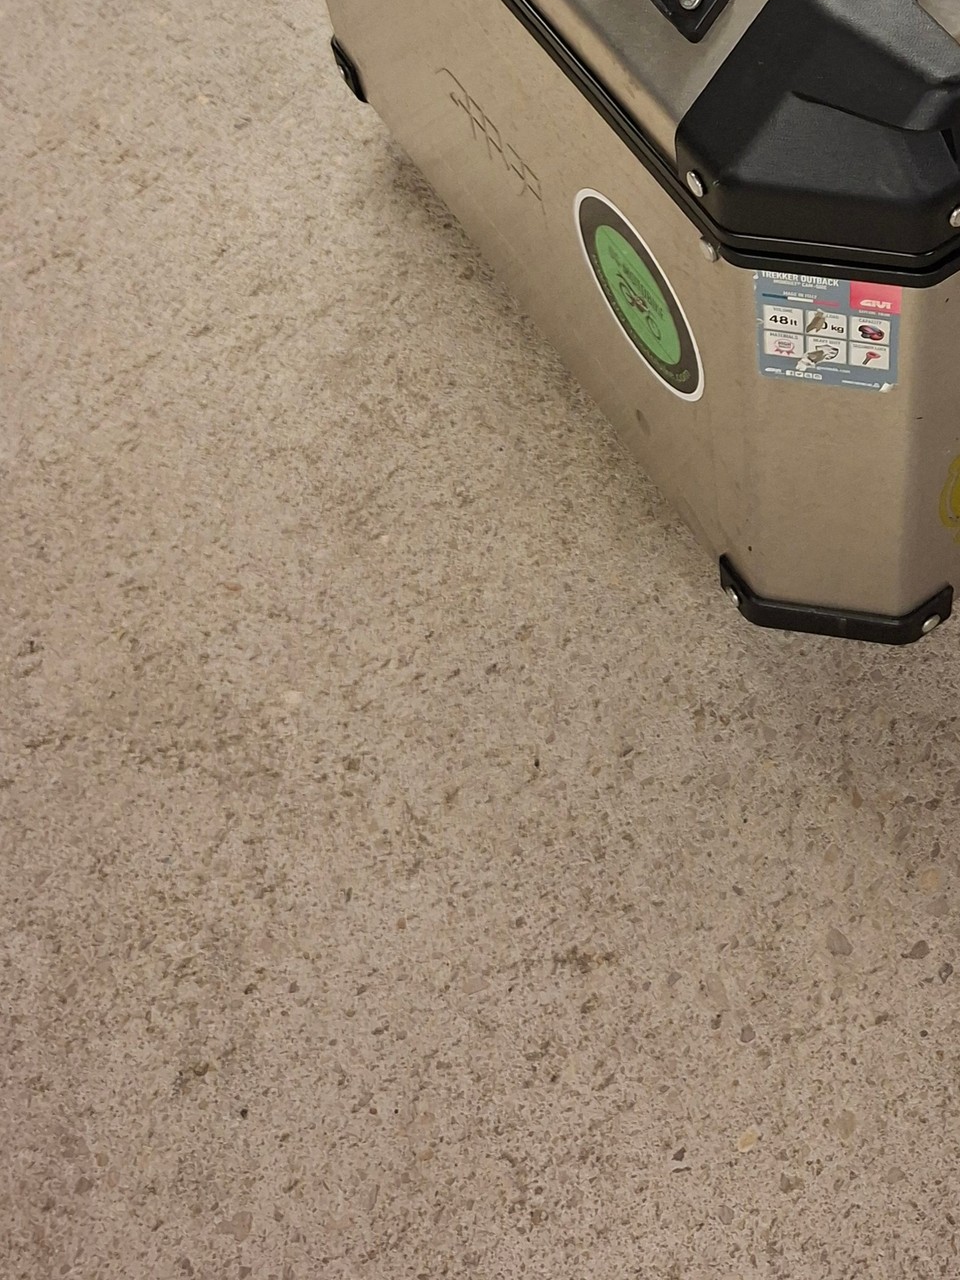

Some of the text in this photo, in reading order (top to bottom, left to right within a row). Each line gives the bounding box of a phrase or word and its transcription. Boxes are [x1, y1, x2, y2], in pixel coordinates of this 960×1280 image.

[762, 270, 839, 287] TREKKER OUTBACK
[859, 299, 892, 309] GIVI
[769, 314, 789, 325] 48
[831, 324, 844, 334] kg
